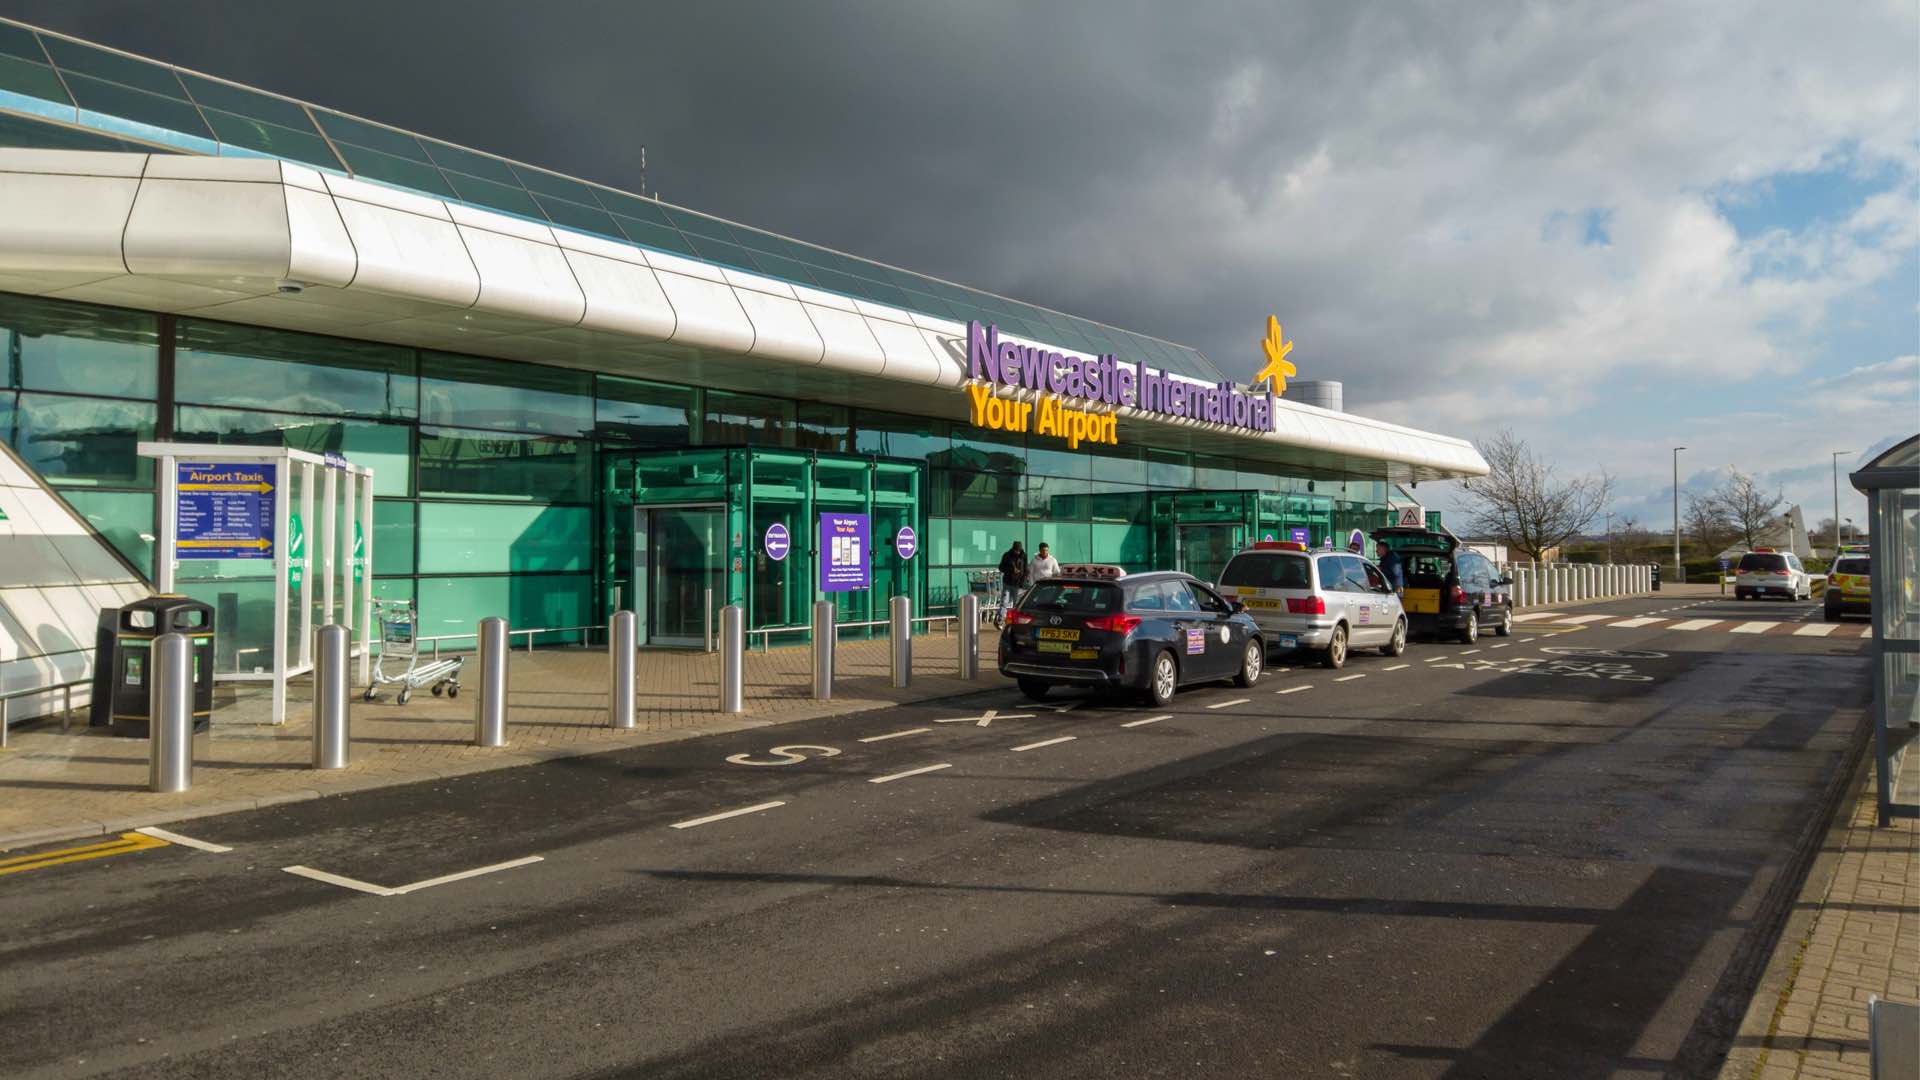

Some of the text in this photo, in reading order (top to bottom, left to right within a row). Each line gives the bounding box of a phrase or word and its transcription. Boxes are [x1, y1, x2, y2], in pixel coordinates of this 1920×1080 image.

[966, 319, 1276, 433] Newcastle International
[966, 383, 1118, 449] Your Airport
[190, 471, 264, 482] Airport Taxis
[1063, 566, 1114, 576] TAXI
[1040, 629, 1079, 640] YP63 SKK
